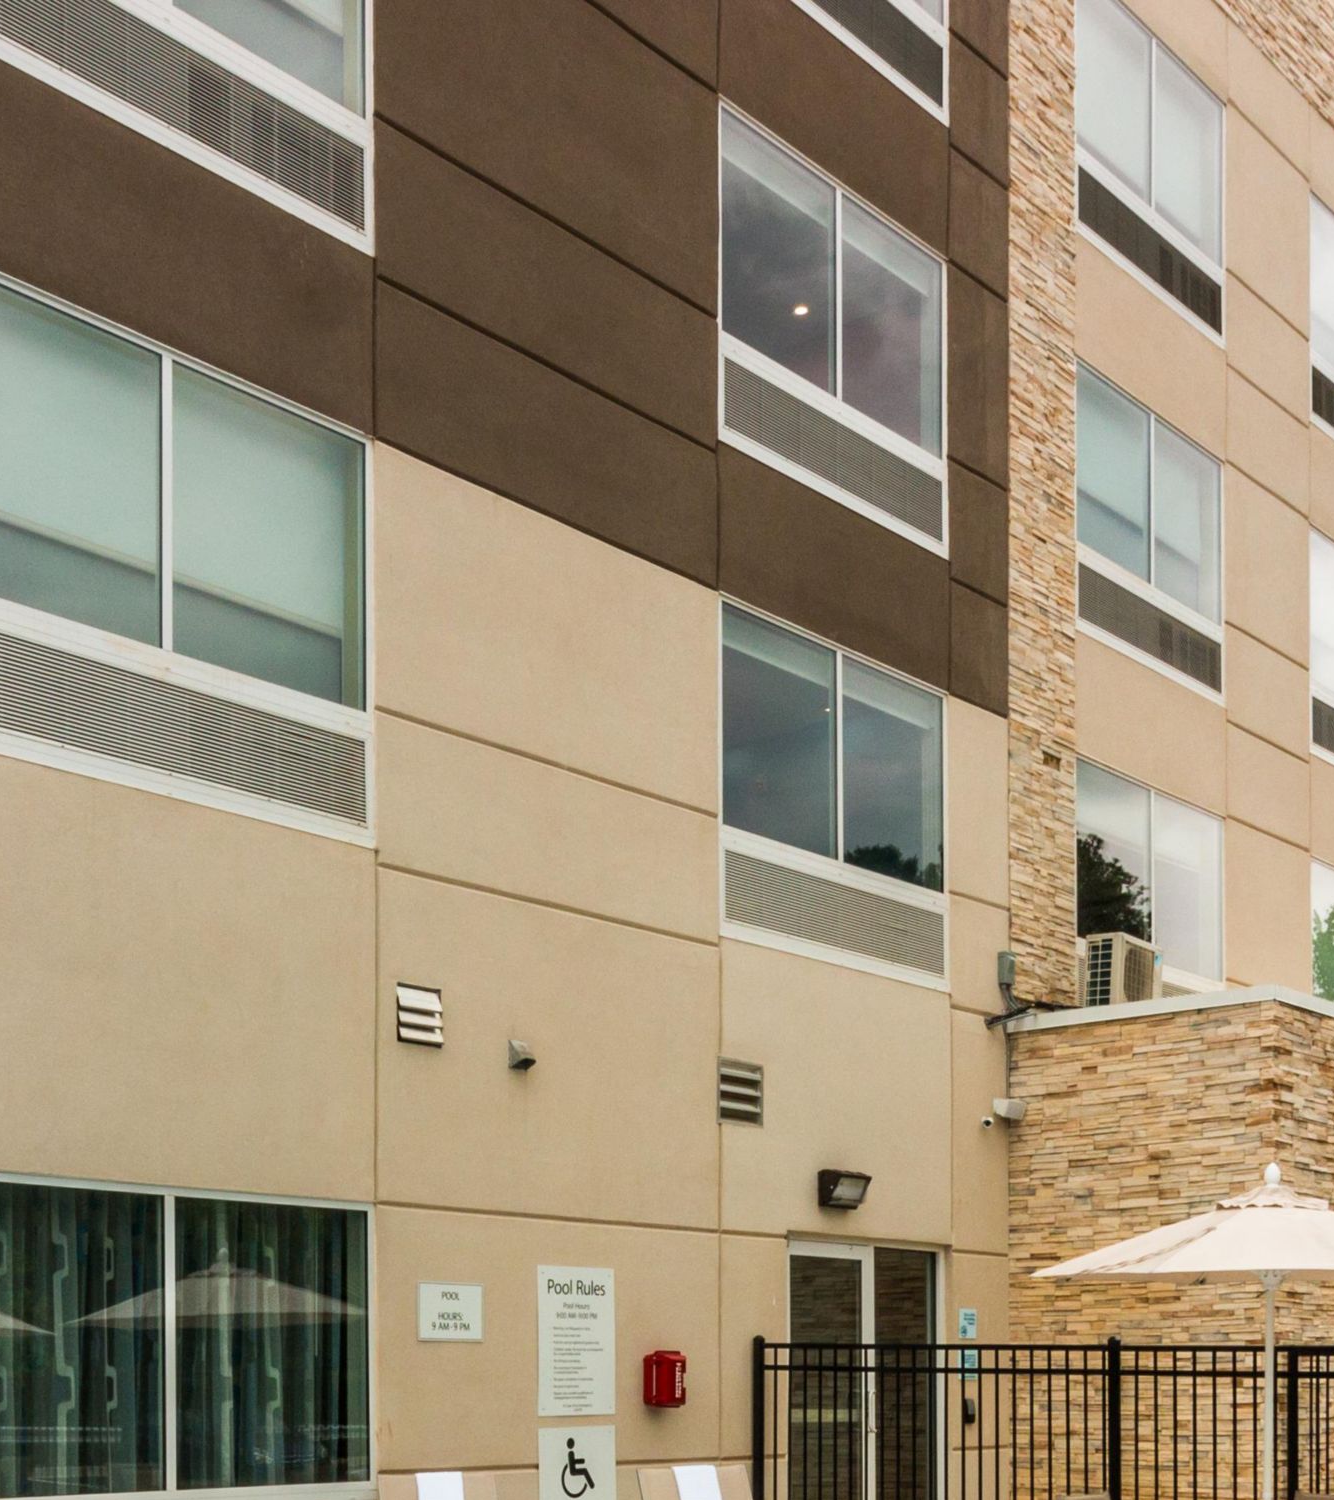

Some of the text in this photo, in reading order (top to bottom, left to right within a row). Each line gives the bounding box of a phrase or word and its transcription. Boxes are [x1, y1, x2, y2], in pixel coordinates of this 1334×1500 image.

[547, 1278, 606, 1297] Pool Rules
[441, 1291, 460, 1301] POOL
[459, 1322, 471, 1332] PM
